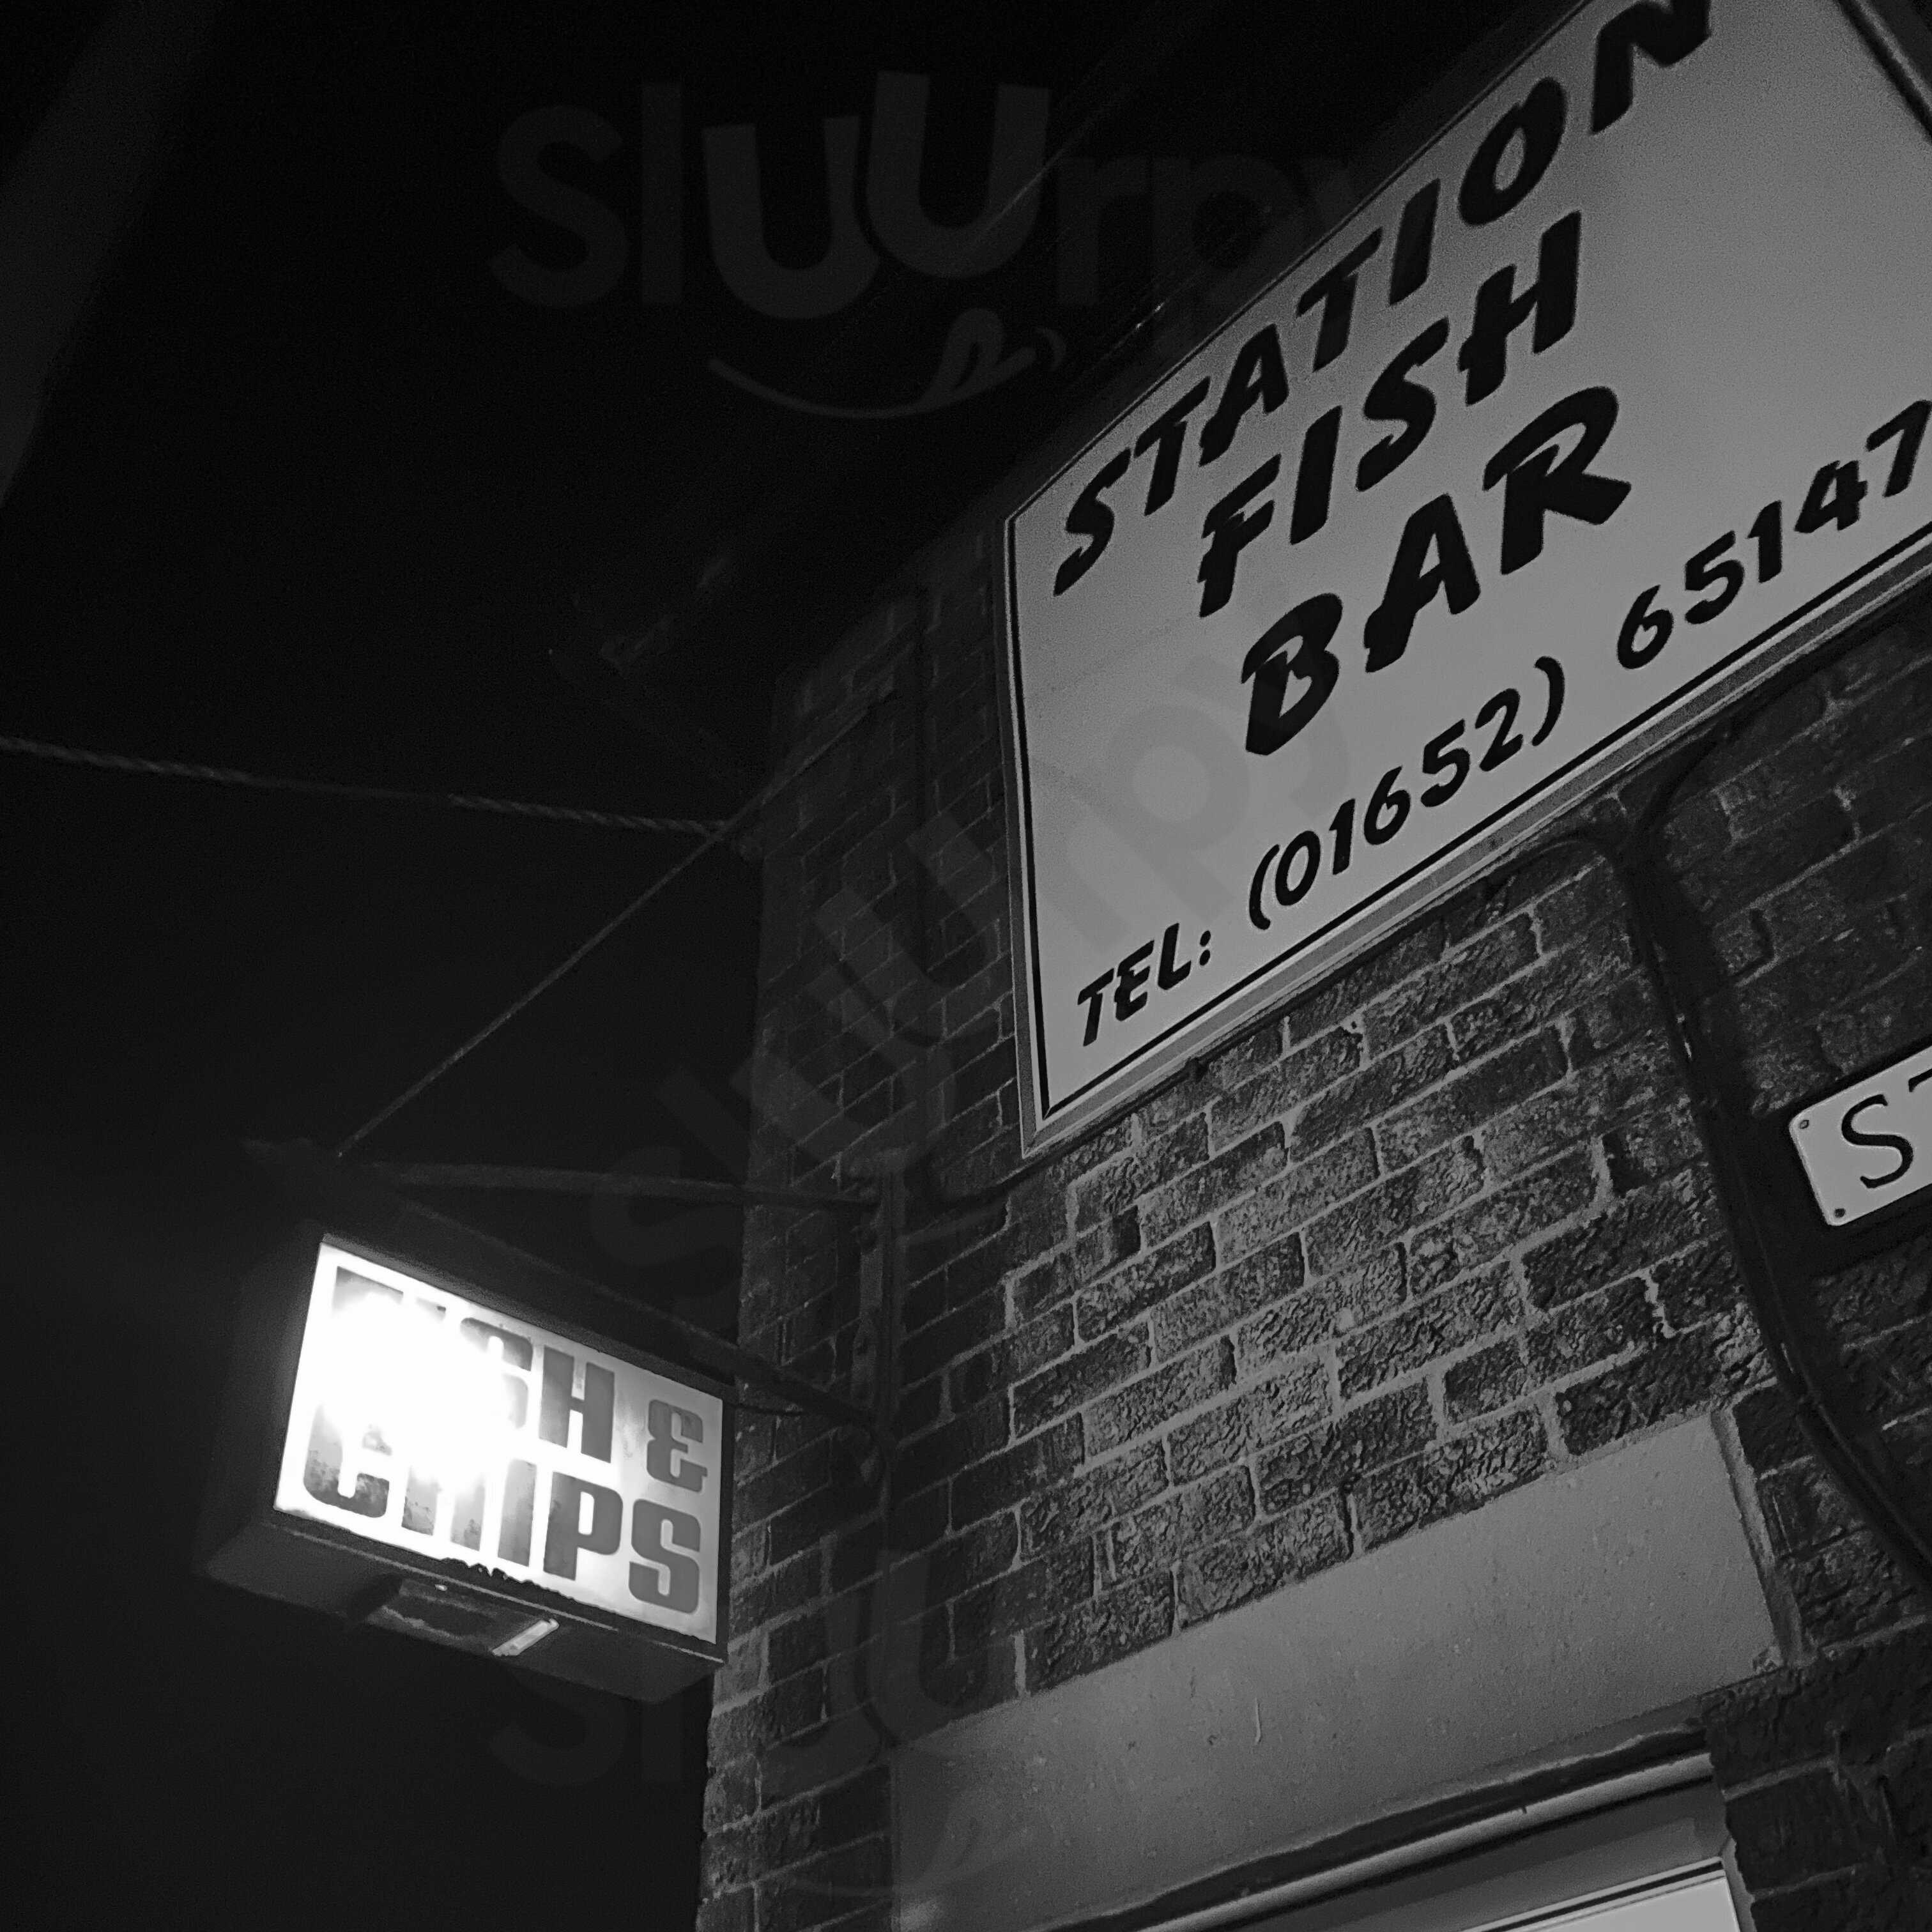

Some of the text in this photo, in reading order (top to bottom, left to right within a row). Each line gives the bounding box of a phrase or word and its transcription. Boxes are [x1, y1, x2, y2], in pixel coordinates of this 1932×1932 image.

[1054, 0, 1710, 597] STATION
[1197, 210, 1581, 618] FISH
[1077, 399, 1932, 1047] TEL: (01652) 65147
[1240, 385, 1632, 756] BAR
[303, 1404, 702, 1614] CHIPS
[331, 1266, 708, 1493] SH &
